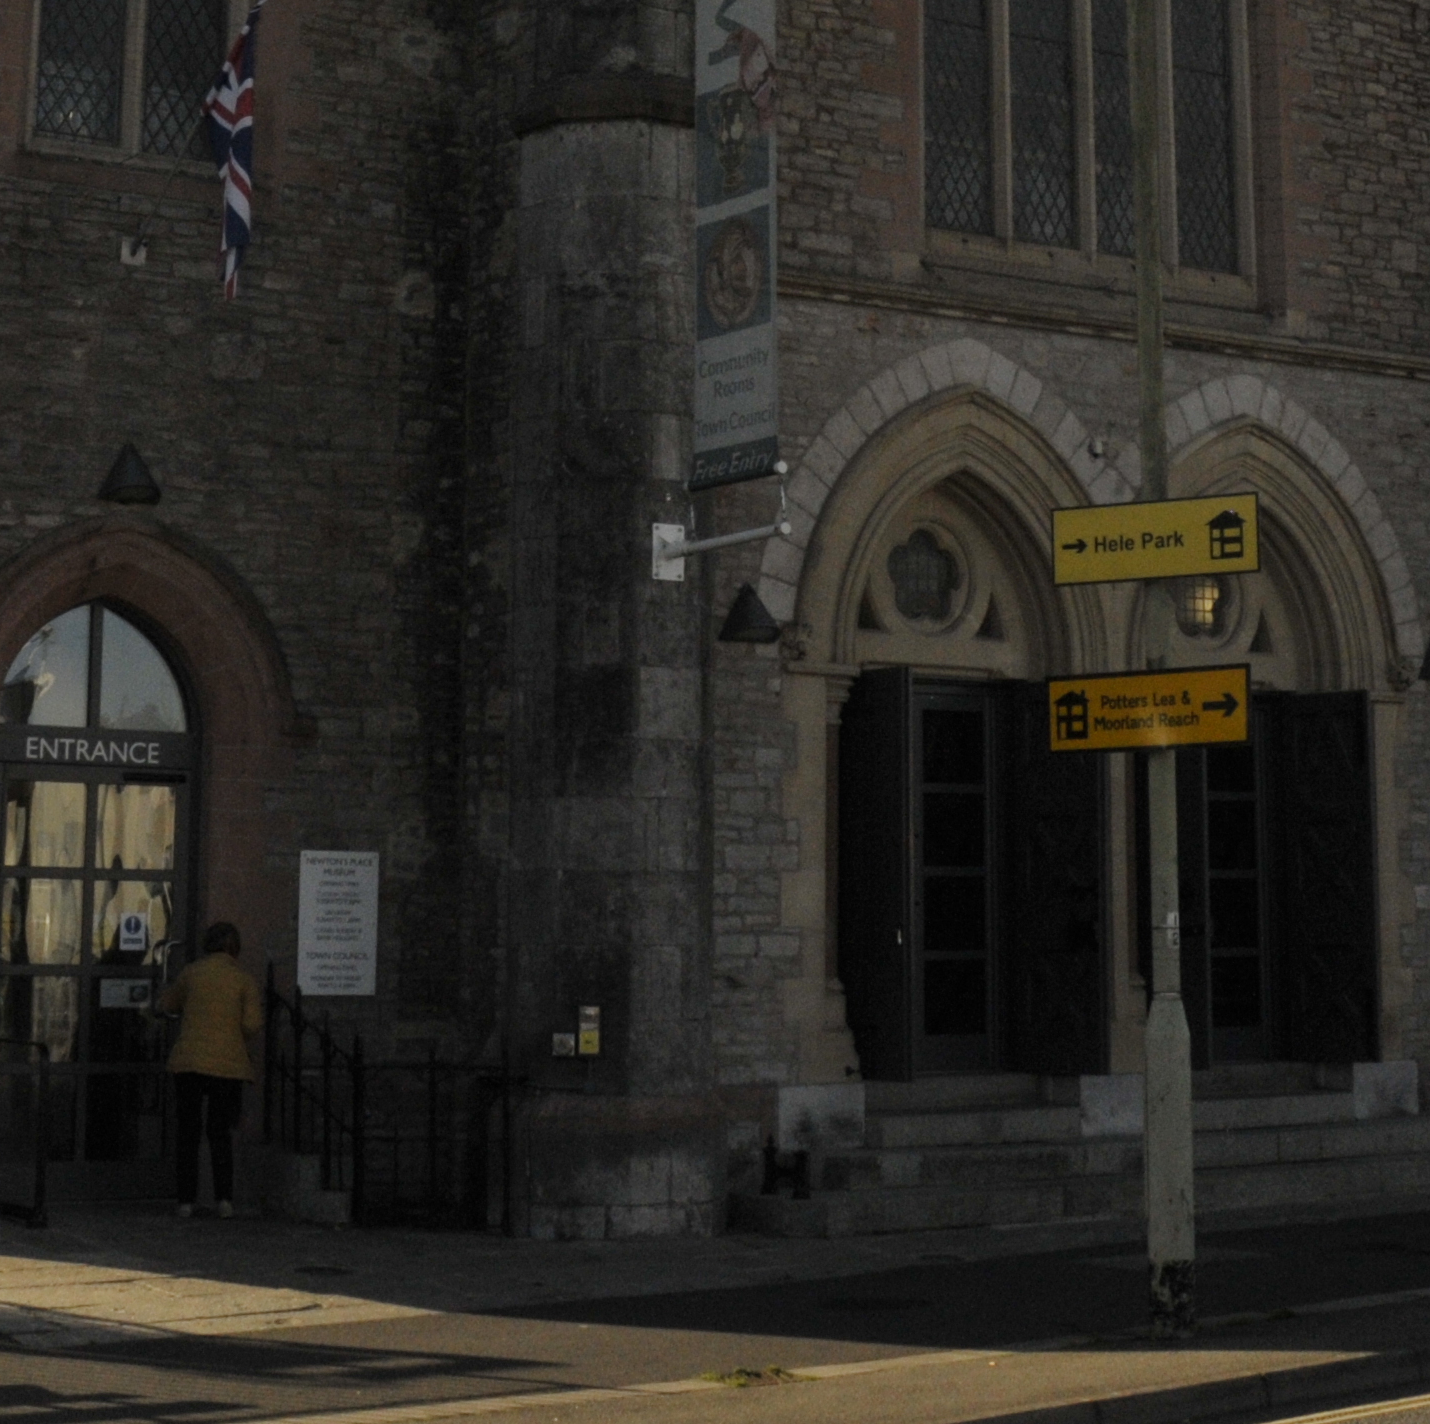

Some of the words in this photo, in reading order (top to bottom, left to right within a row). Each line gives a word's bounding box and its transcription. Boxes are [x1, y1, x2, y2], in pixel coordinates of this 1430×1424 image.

[698, 347, 770, 379] Community
[713, 376, 756, 399] Rooms
[696, 418, 728, 438] Town
[729, 406, 775, 430] Council
[694, 459, 729, 481] Free
[728, 451, 774, 475] Entry
[1094, 535, 1135, 553] Hele
[1141, 531, 1185, 550] Park
[1100, 694, 1149, 710] Potters
[1152, 692, 1177, 707] Lea
[1181, 689, 1191, 706] &
[1094, 714, 1155, 732] Moorland
[1158, 711, 1200, 728] Reach
[25, 736, 160, 764] ENTRANCE
